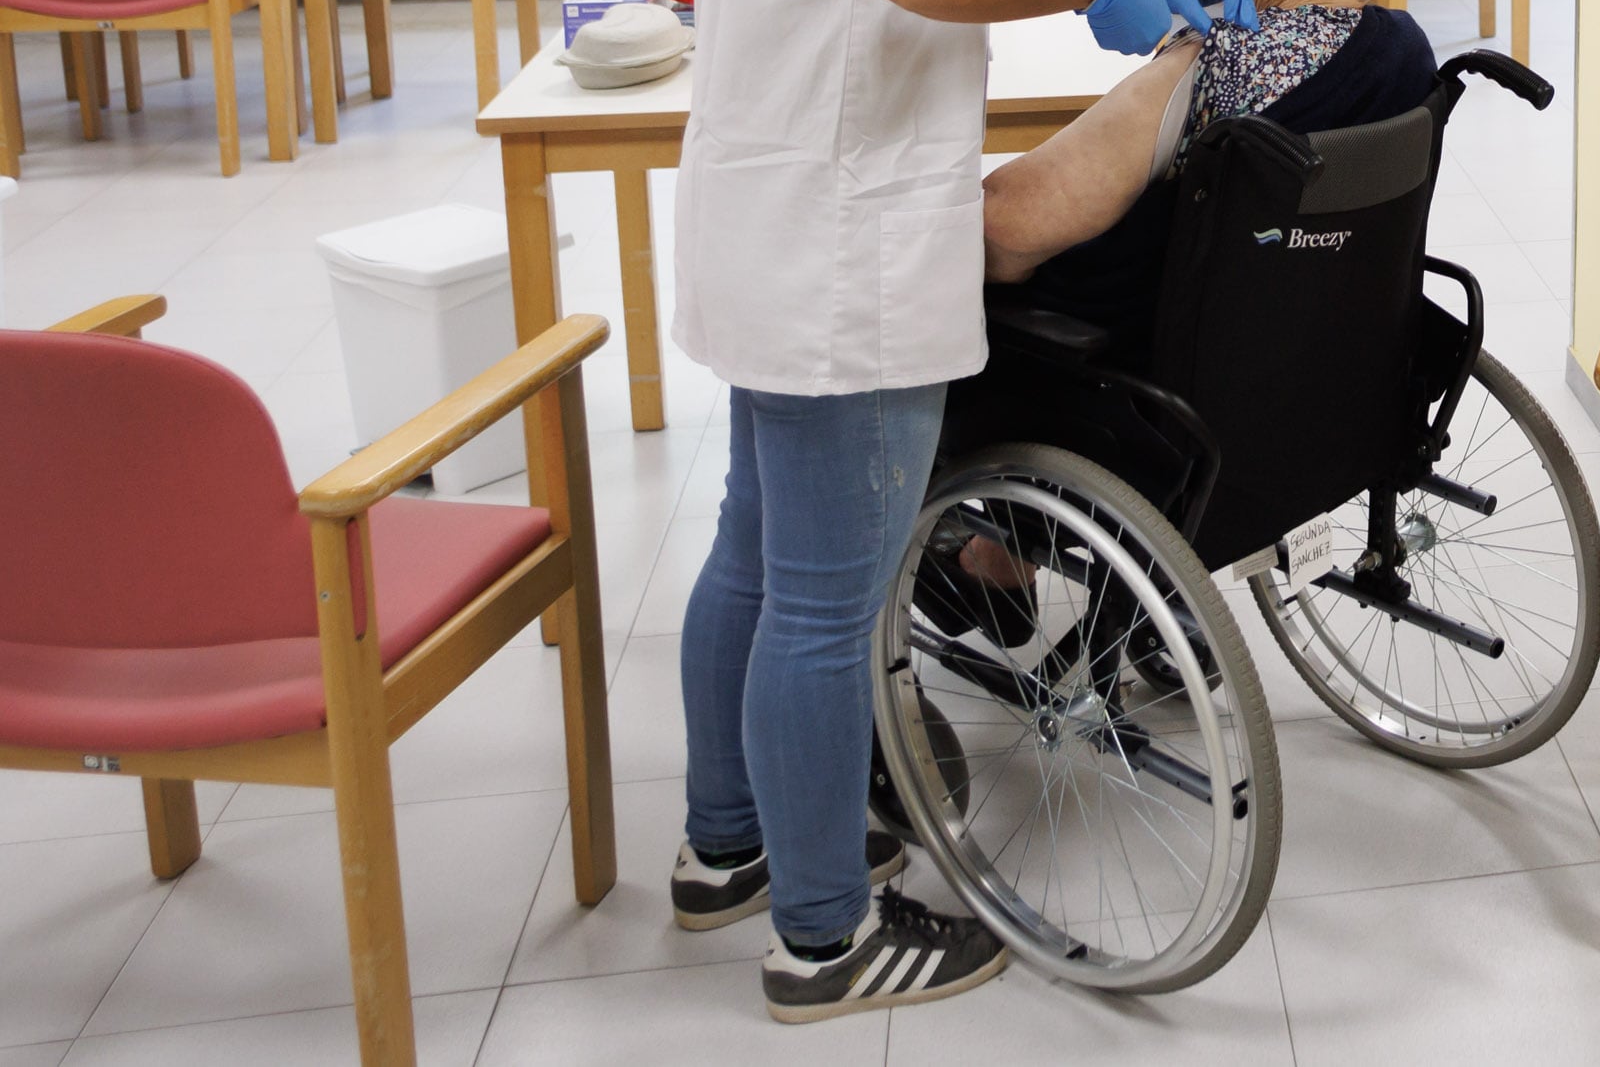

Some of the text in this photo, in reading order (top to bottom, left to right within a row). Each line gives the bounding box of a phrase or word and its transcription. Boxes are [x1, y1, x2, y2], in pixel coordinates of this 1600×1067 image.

[1287, 228, 1349, 251] Breezy
[1290, 520, 1331, 553] SEGUNDA
[1291, 541, 1331, 577] SANCHEZ
